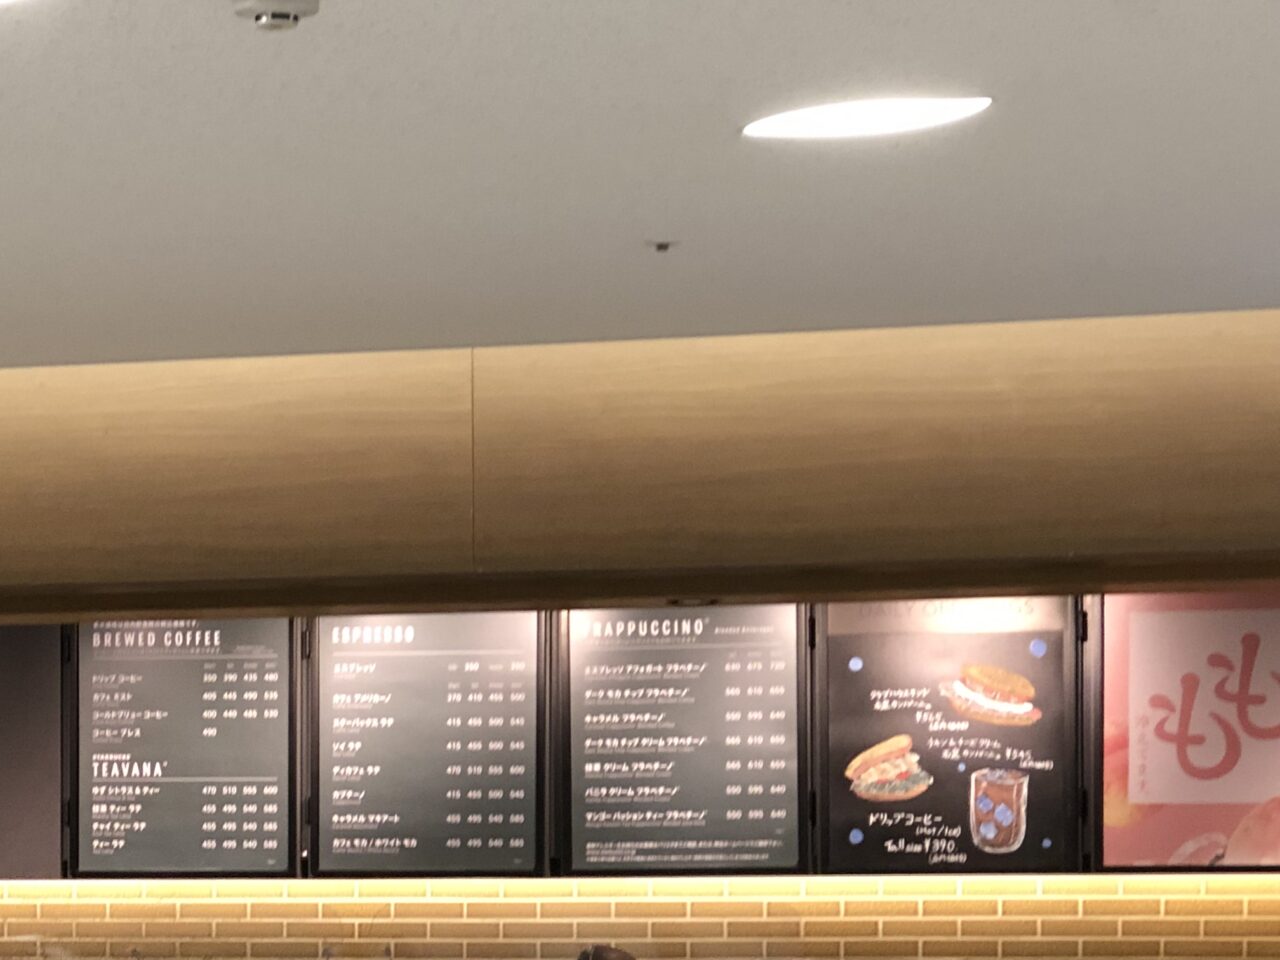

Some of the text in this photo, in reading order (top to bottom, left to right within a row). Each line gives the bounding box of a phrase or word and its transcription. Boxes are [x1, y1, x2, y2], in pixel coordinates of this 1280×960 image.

[588, 619, 704, 638] RAPPUCCINO
[93, 630, 220, 647] BREWED COFFEE
[243, 673, 257, 682] 435
